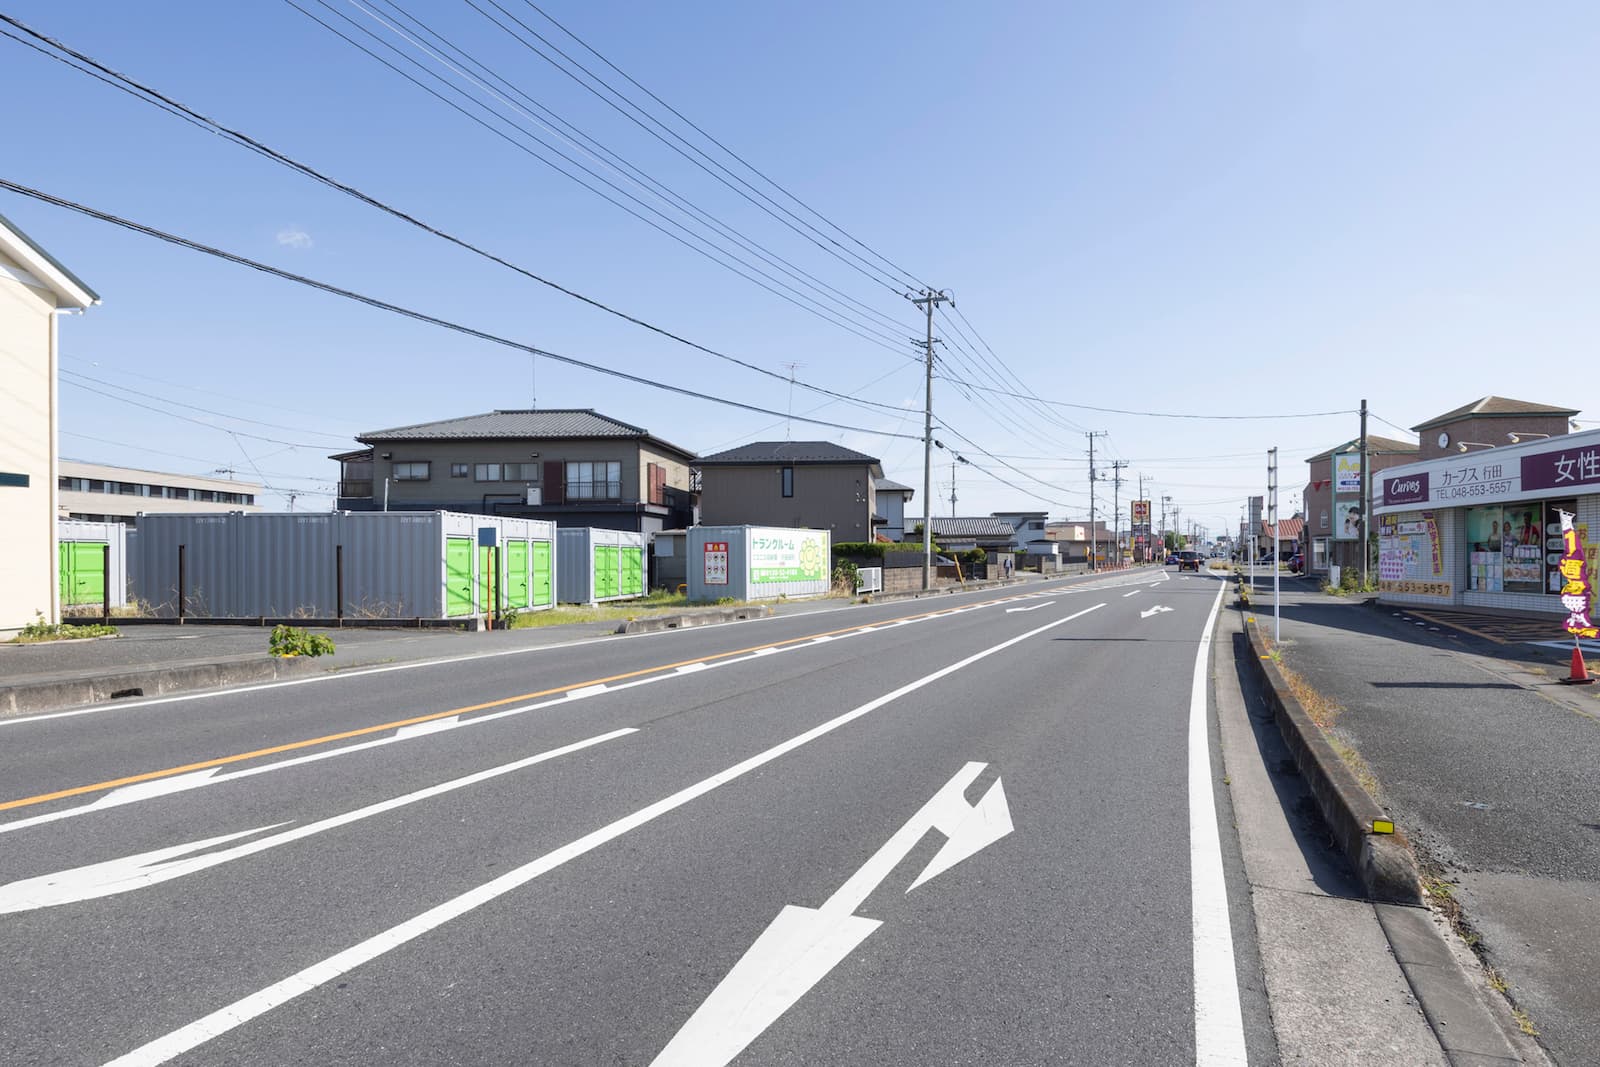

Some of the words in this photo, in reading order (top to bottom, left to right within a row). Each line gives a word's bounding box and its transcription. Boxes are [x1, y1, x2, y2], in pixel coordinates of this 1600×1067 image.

[1442, 467, 1479, 486] カーブス
[1483, 464, 1502, 480] 行田
[1554, 450, 1600, 482] 女性
[1391, 478, 1420, 496] Curves
[1436, 488, 1449, 499] TEL
[1451, 481, 1512, 498] 048-553-5557
[752, 538, 795, 551] トランクルーム
